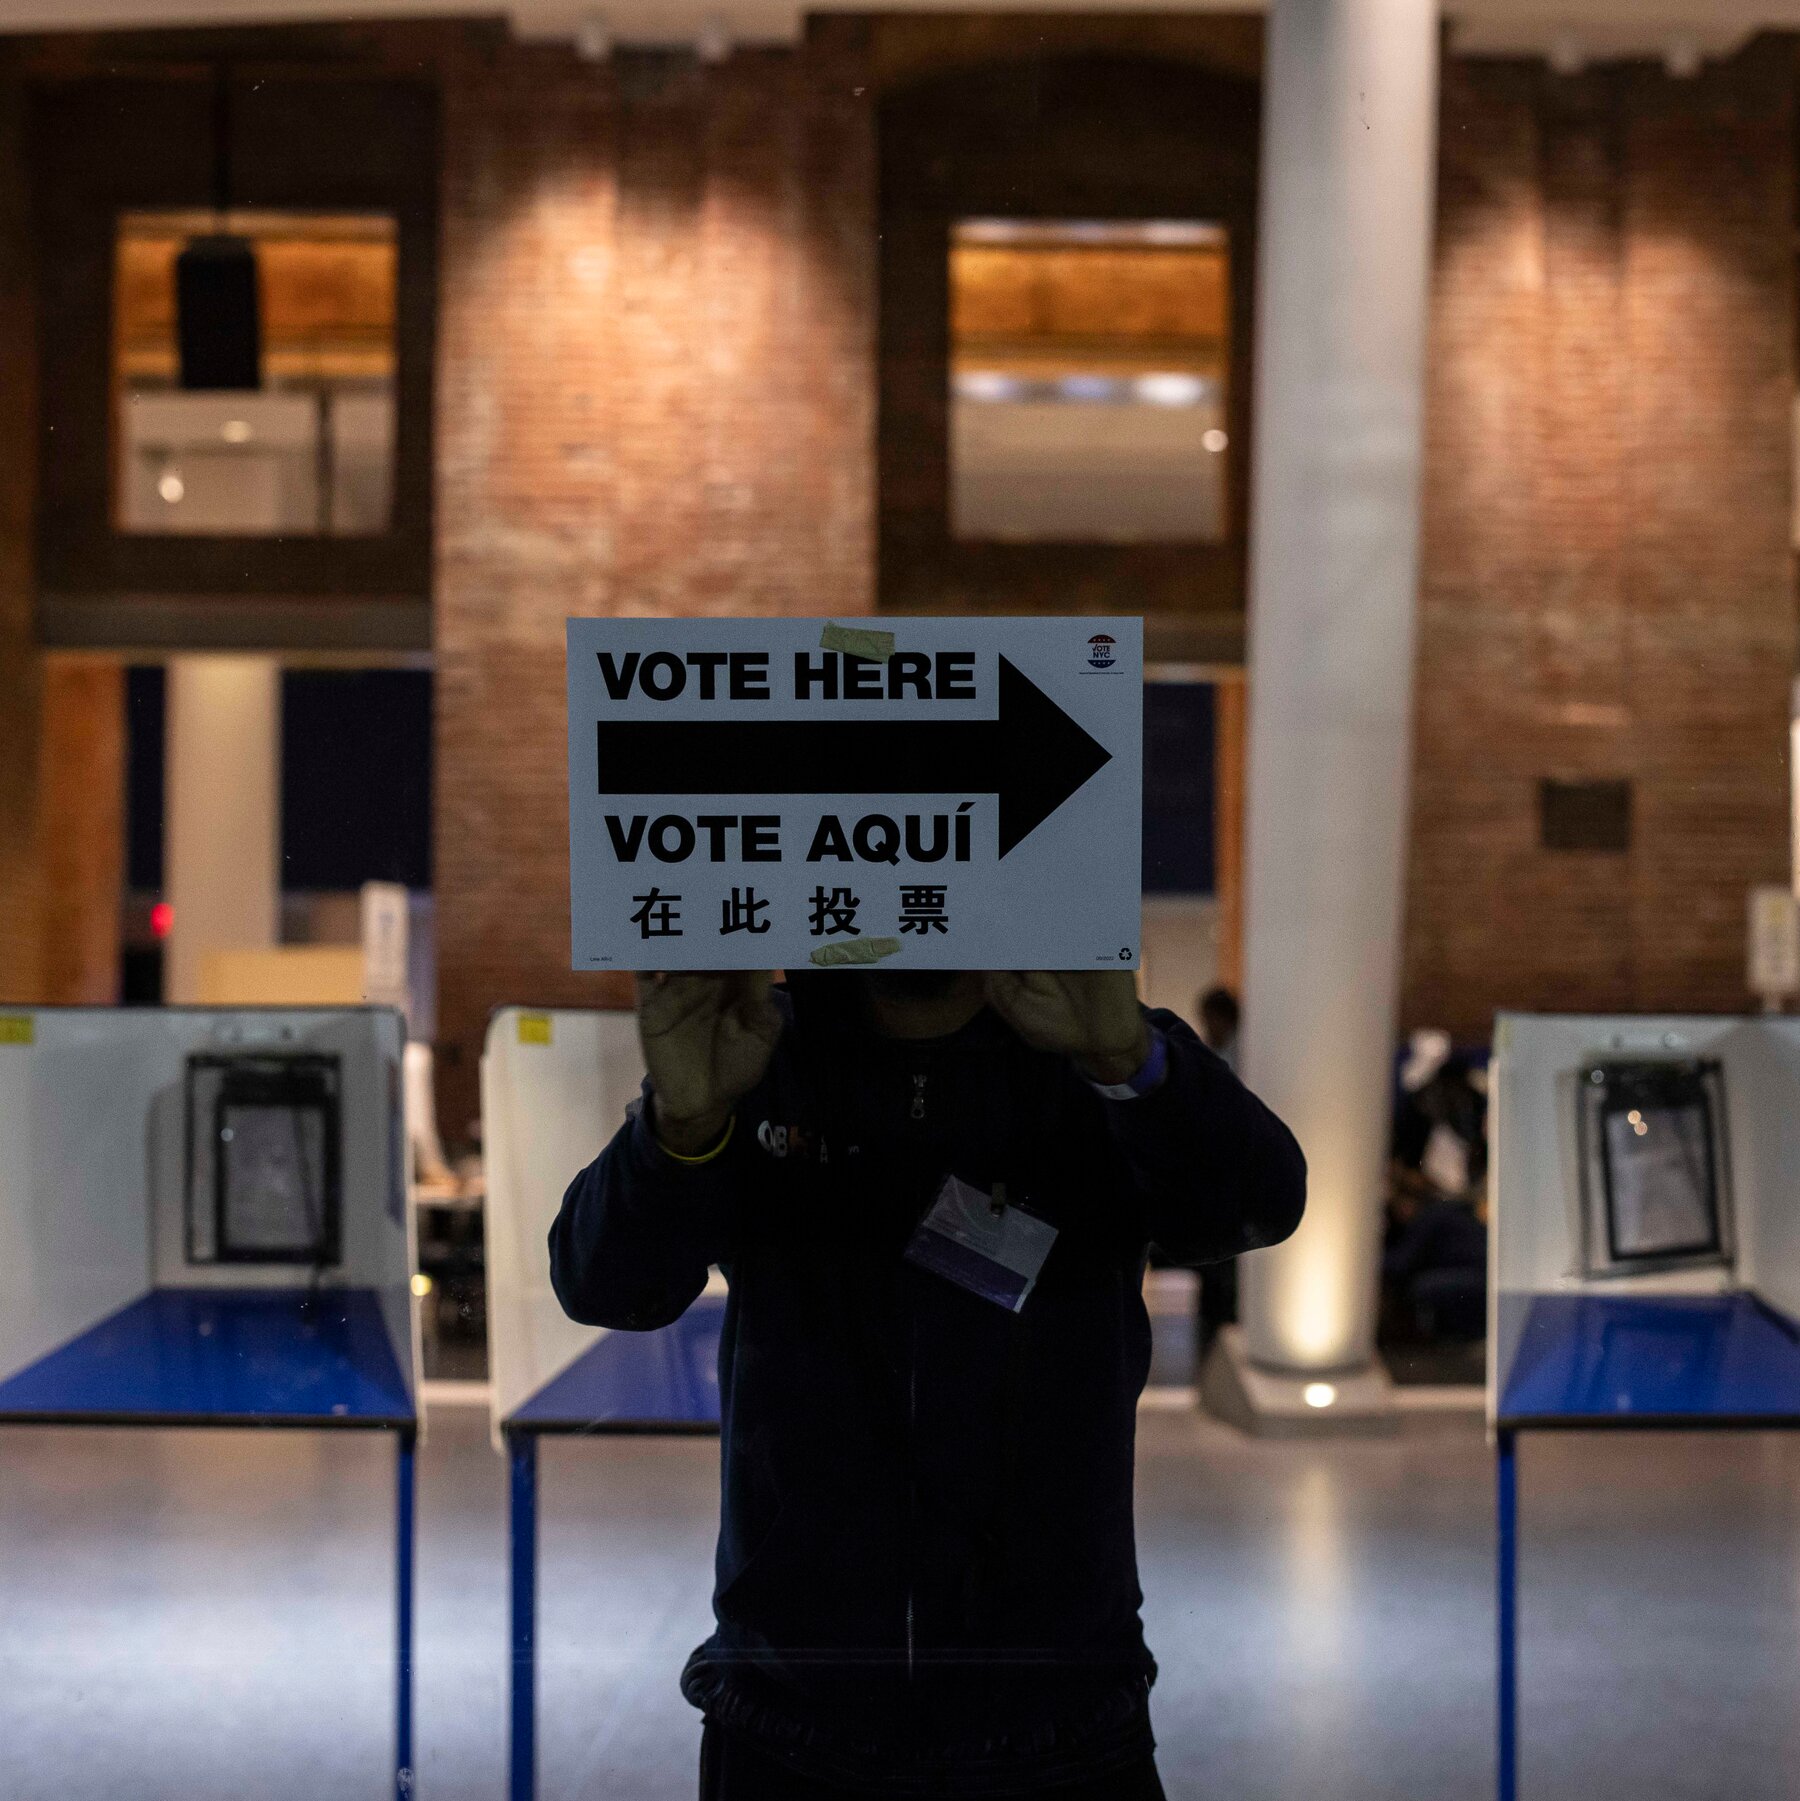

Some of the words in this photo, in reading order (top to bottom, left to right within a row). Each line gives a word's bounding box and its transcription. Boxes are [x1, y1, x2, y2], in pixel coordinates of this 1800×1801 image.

[595, 652, 770, 701] VOTE
[795, 652, 976, 700] HERE
[604, 814, 781, 864] VOTE
[805, 801, 977, 866] AQUÍ
[630, 885, 949, 940] 在此投票
